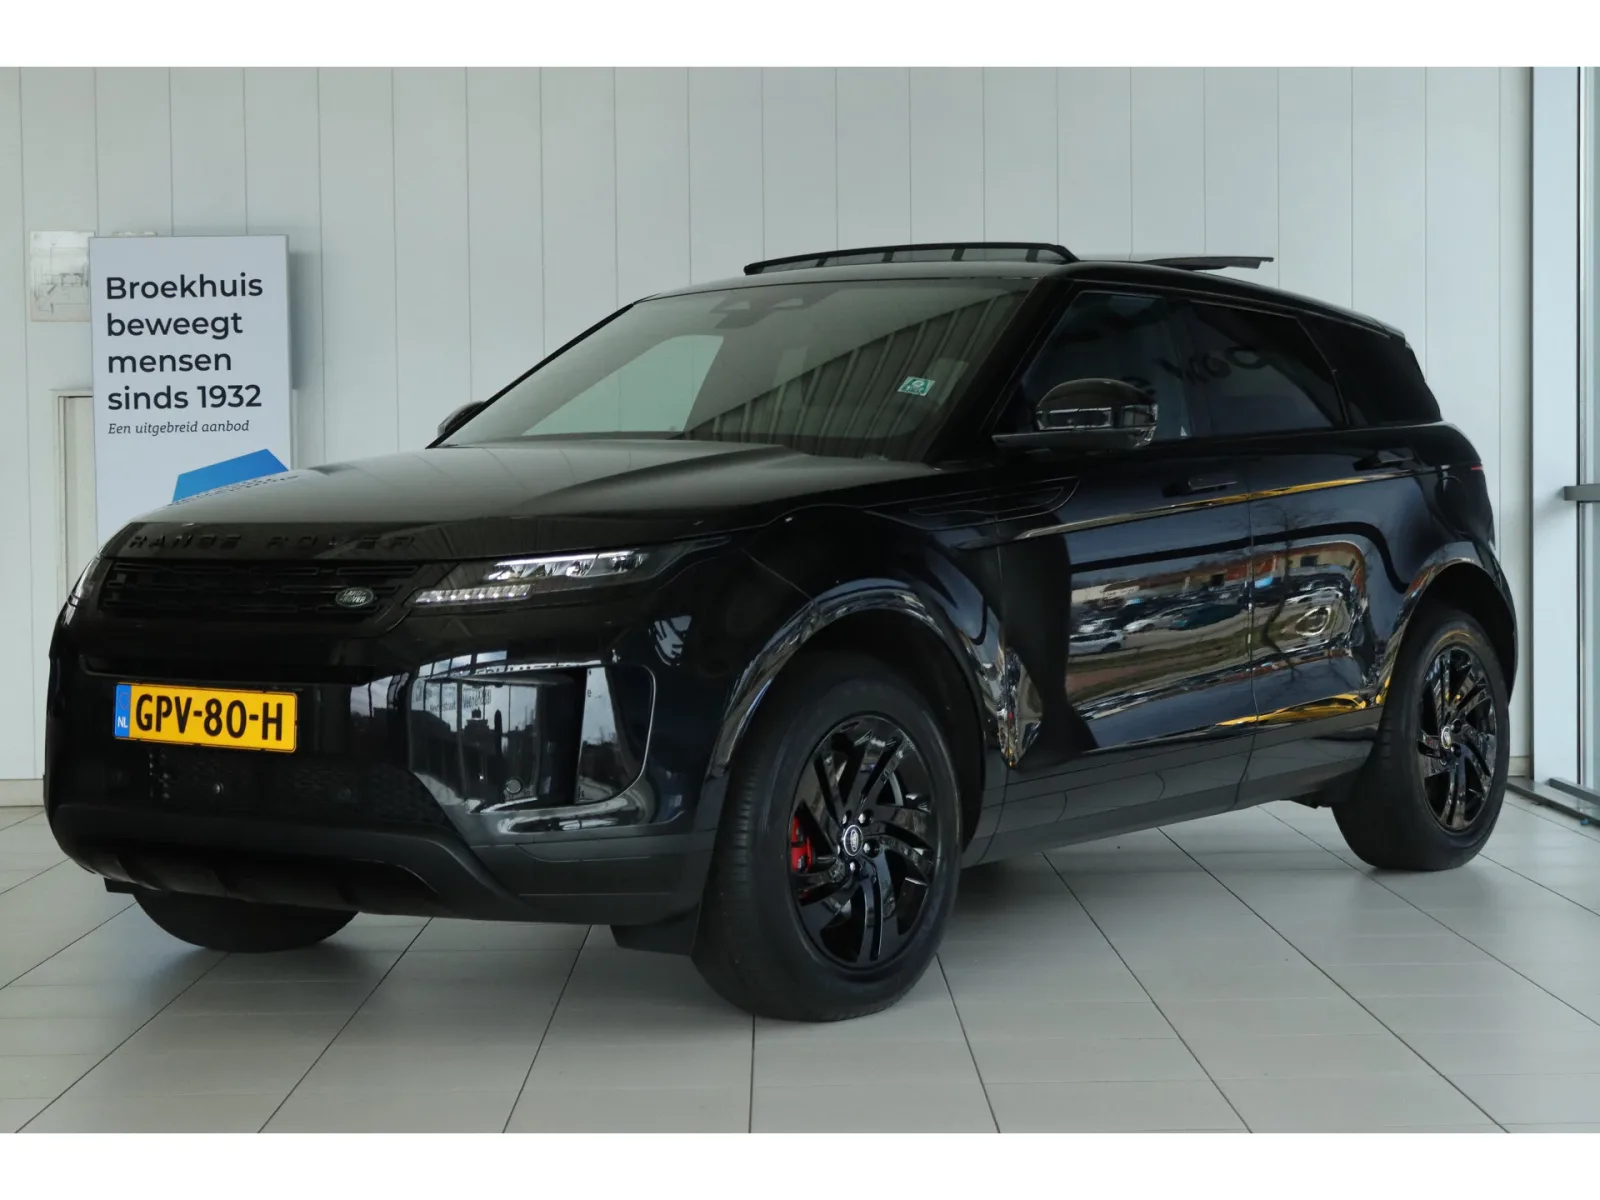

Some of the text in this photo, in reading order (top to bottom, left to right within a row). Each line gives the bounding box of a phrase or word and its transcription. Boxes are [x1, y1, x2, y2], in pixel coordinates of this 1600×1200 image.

[106, 272, 263, 300] Broekhuis
[107, 312, 243, 340] beweegt
[108, 353, 232, 373] mensen
[108, 384, 262, 410] sinds 1932
[108, 420, 250, 436] Een uitgebreid aanbod
[117, 716, 129, 729] NL
[135, 693, 283, 741] GPV-80-H
